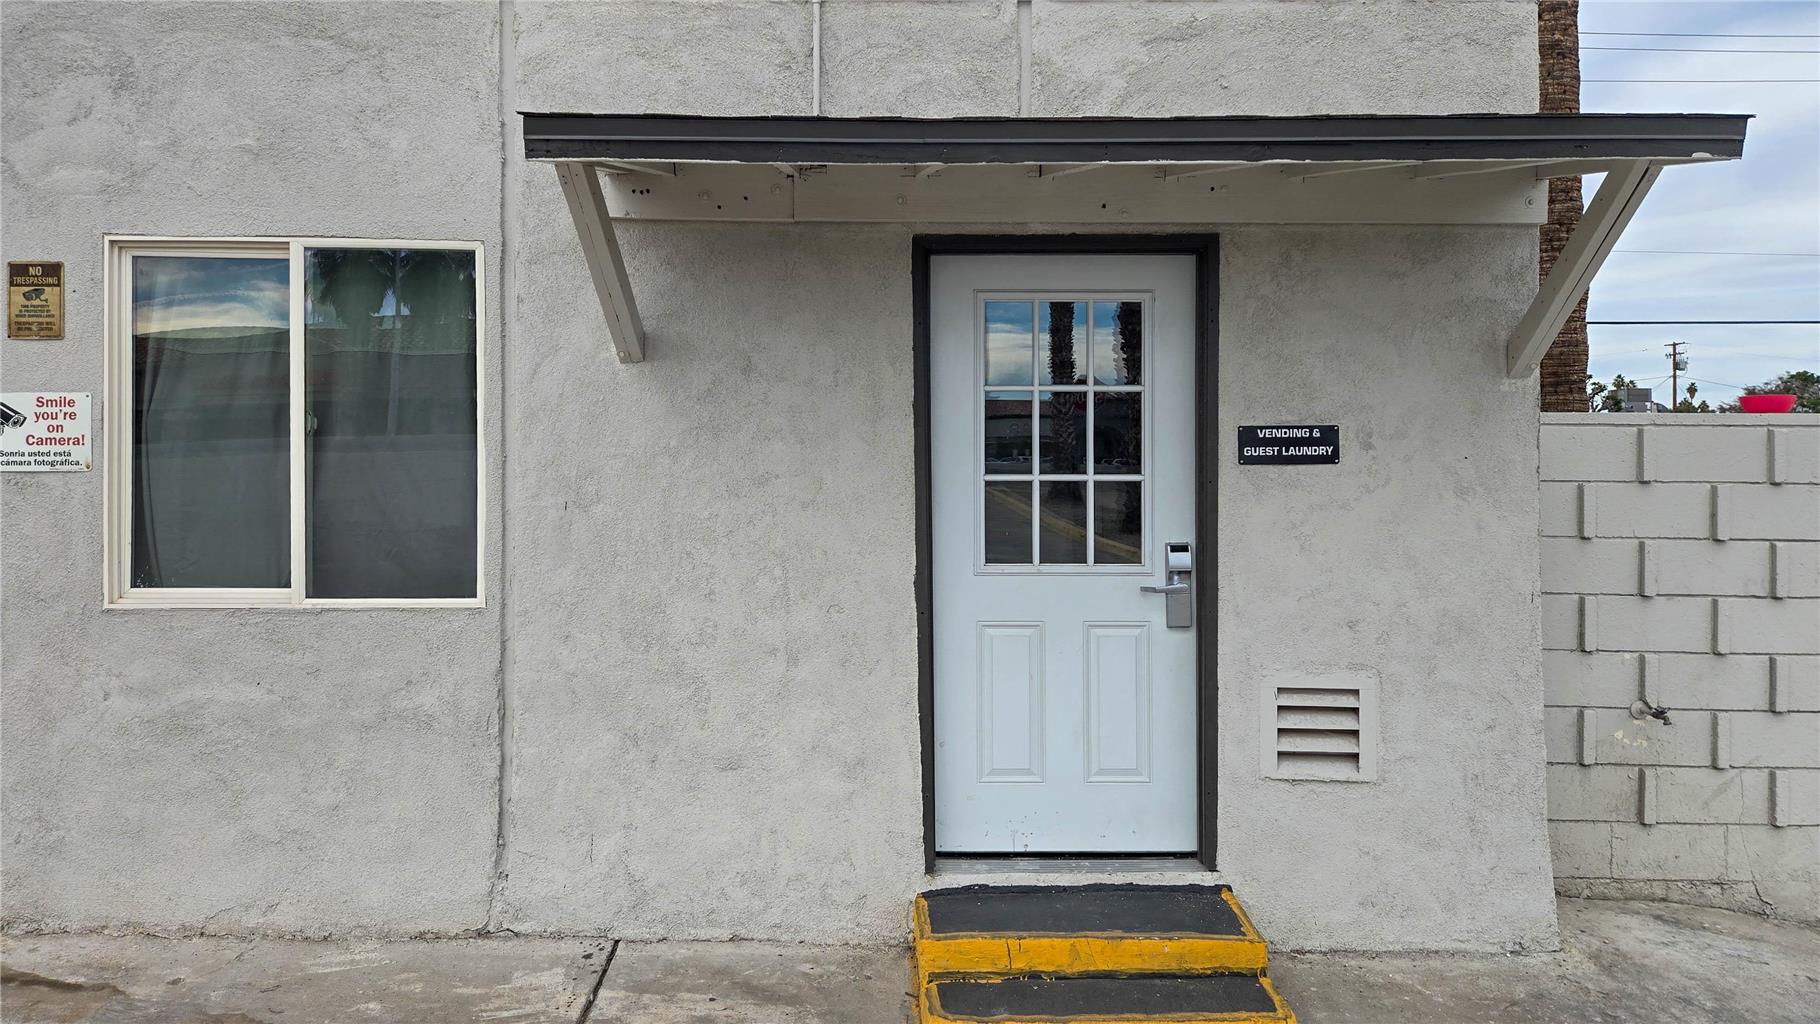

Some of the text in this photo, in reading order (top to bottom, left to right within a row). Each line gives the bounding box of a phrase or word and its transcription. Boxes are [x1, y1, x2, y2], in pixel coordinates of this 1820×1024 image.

[29, 266, 42, 276] NO
[13, 277, 58, 285] TRESPASSING
[36, 396, 76, 407] Smile
[34, 409, 77, 423] you're
[47, 424, 64, 433] on
[1257, 428, 1321, 438] VENDING &
[25, 434, 85, 446] Camera!
[53, 449, 72, 457] está
[1244, 446, 1334, 456] GUEST LAUNDRY
[34, 458, 83, 467] fotográfica.
